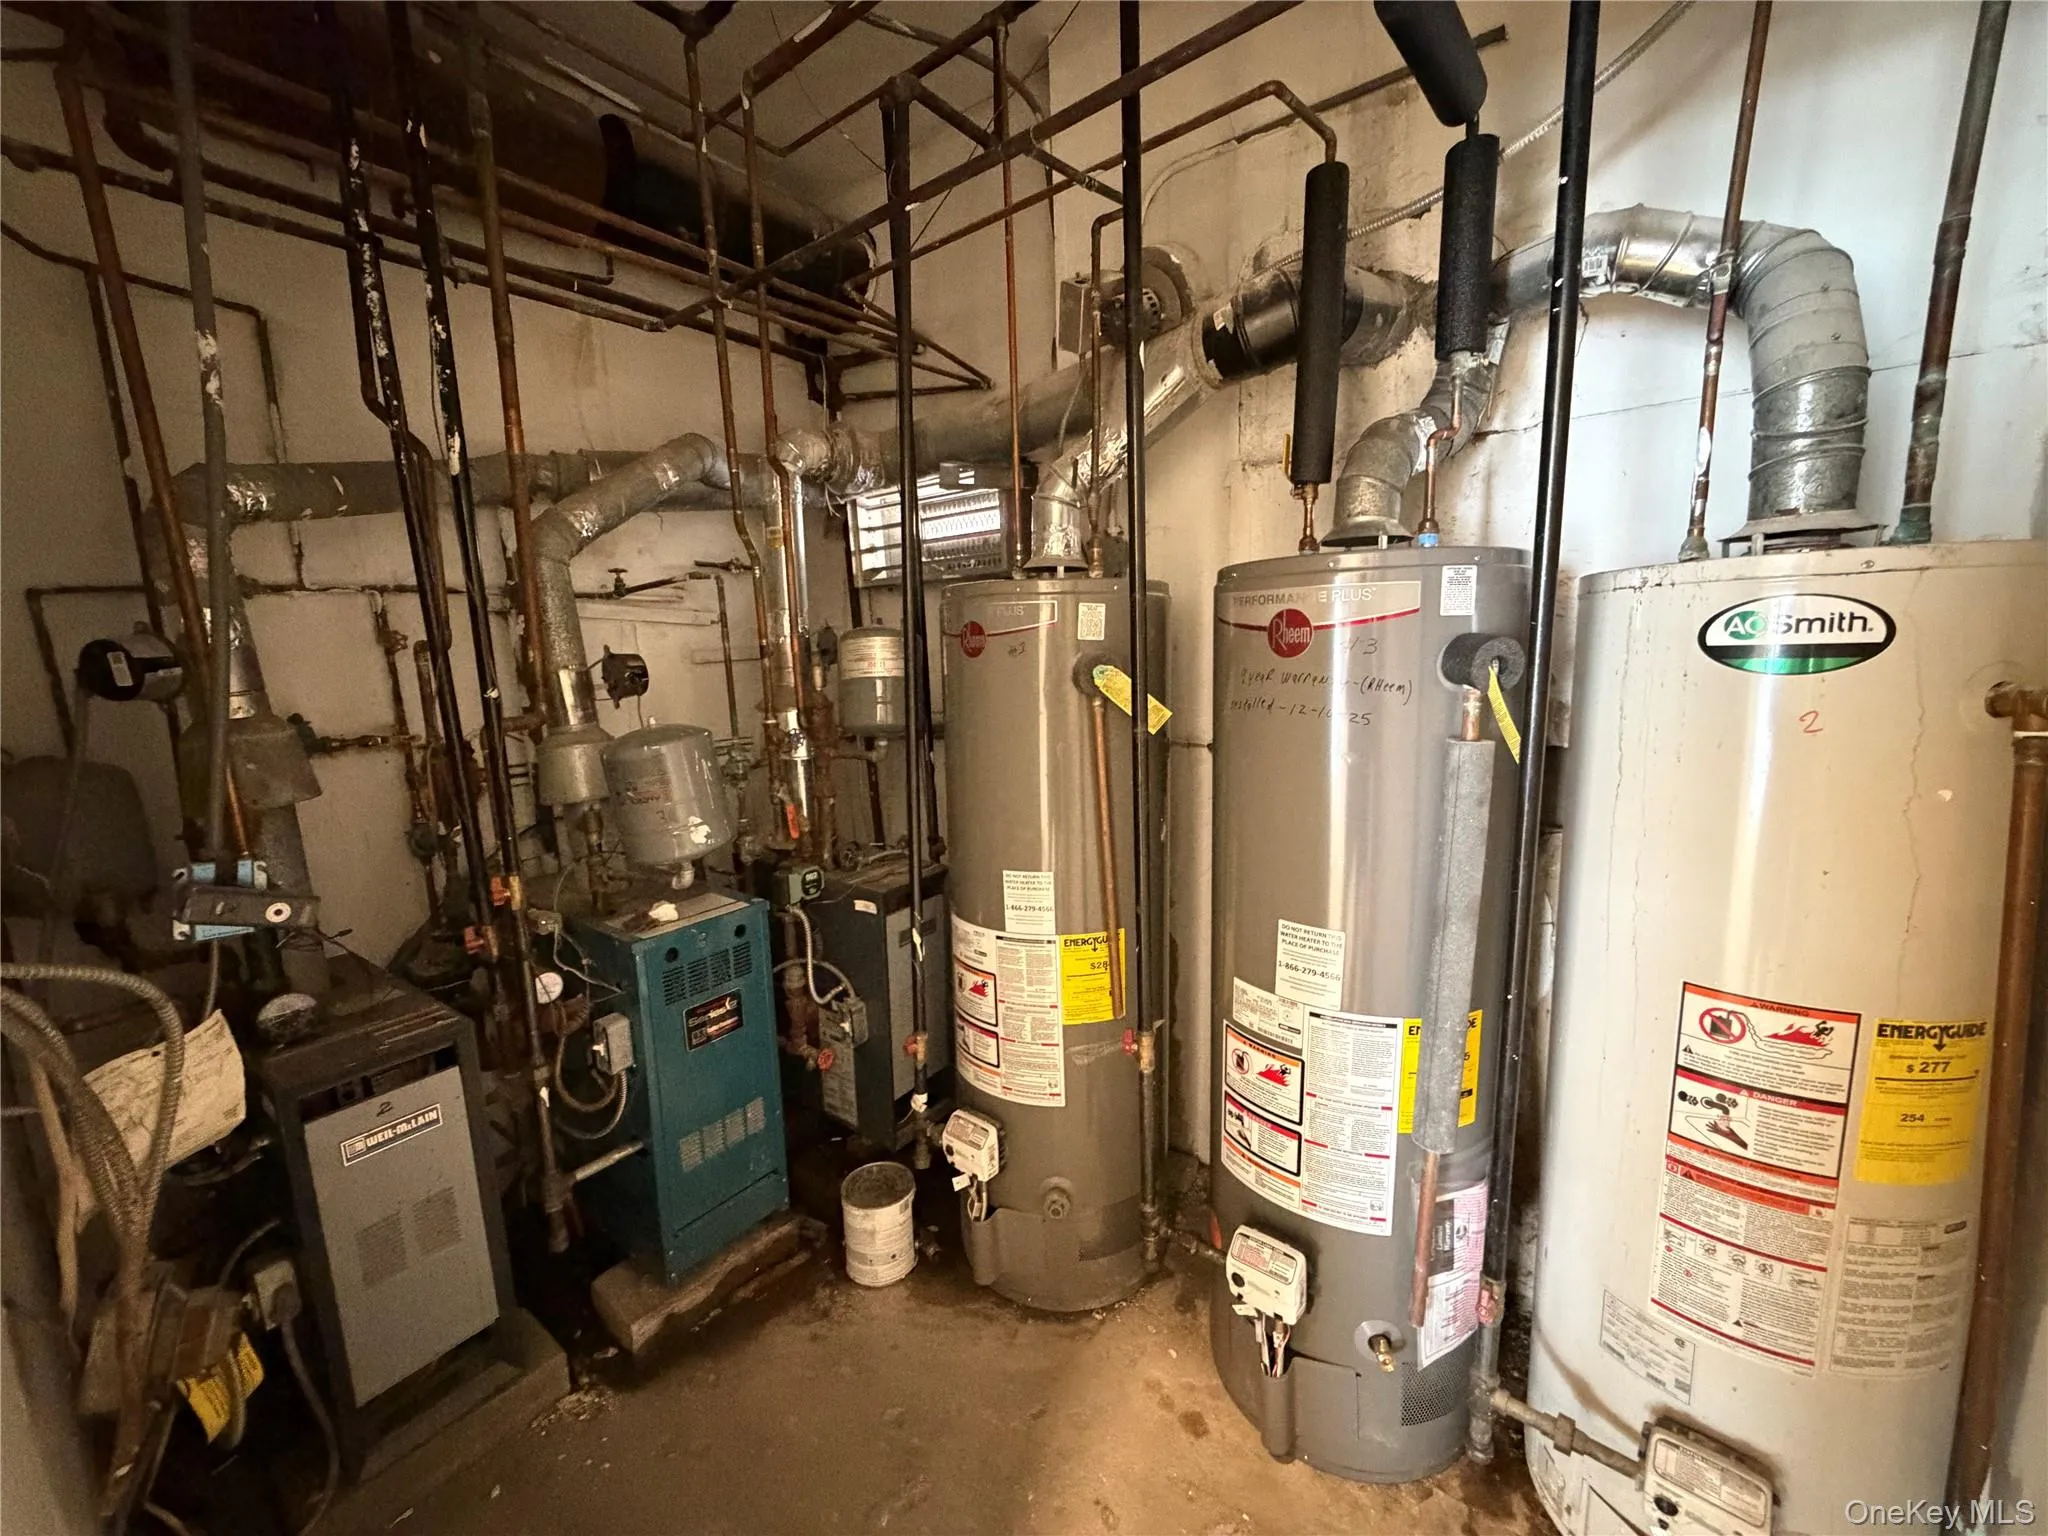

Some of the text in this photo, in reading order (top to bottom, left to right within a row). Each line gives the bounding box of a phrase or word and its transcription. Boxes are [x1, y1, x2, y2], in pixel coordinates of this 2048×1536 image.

[1272, 609, 1311, 651] Rheem
[1799, 710, 1824, 735] 2
[1760, 1002, 1810, 1018] WARNING
[1877, 1021, 1988, 1040] ENERGYGUIDE
[1918, 1061, 1952, 1074] 277
[1752, 1091, 1799, 1108] DANGER
[376, 1101, 393, 1118] 2
[1900, 1112, 1926, 1123] 254
